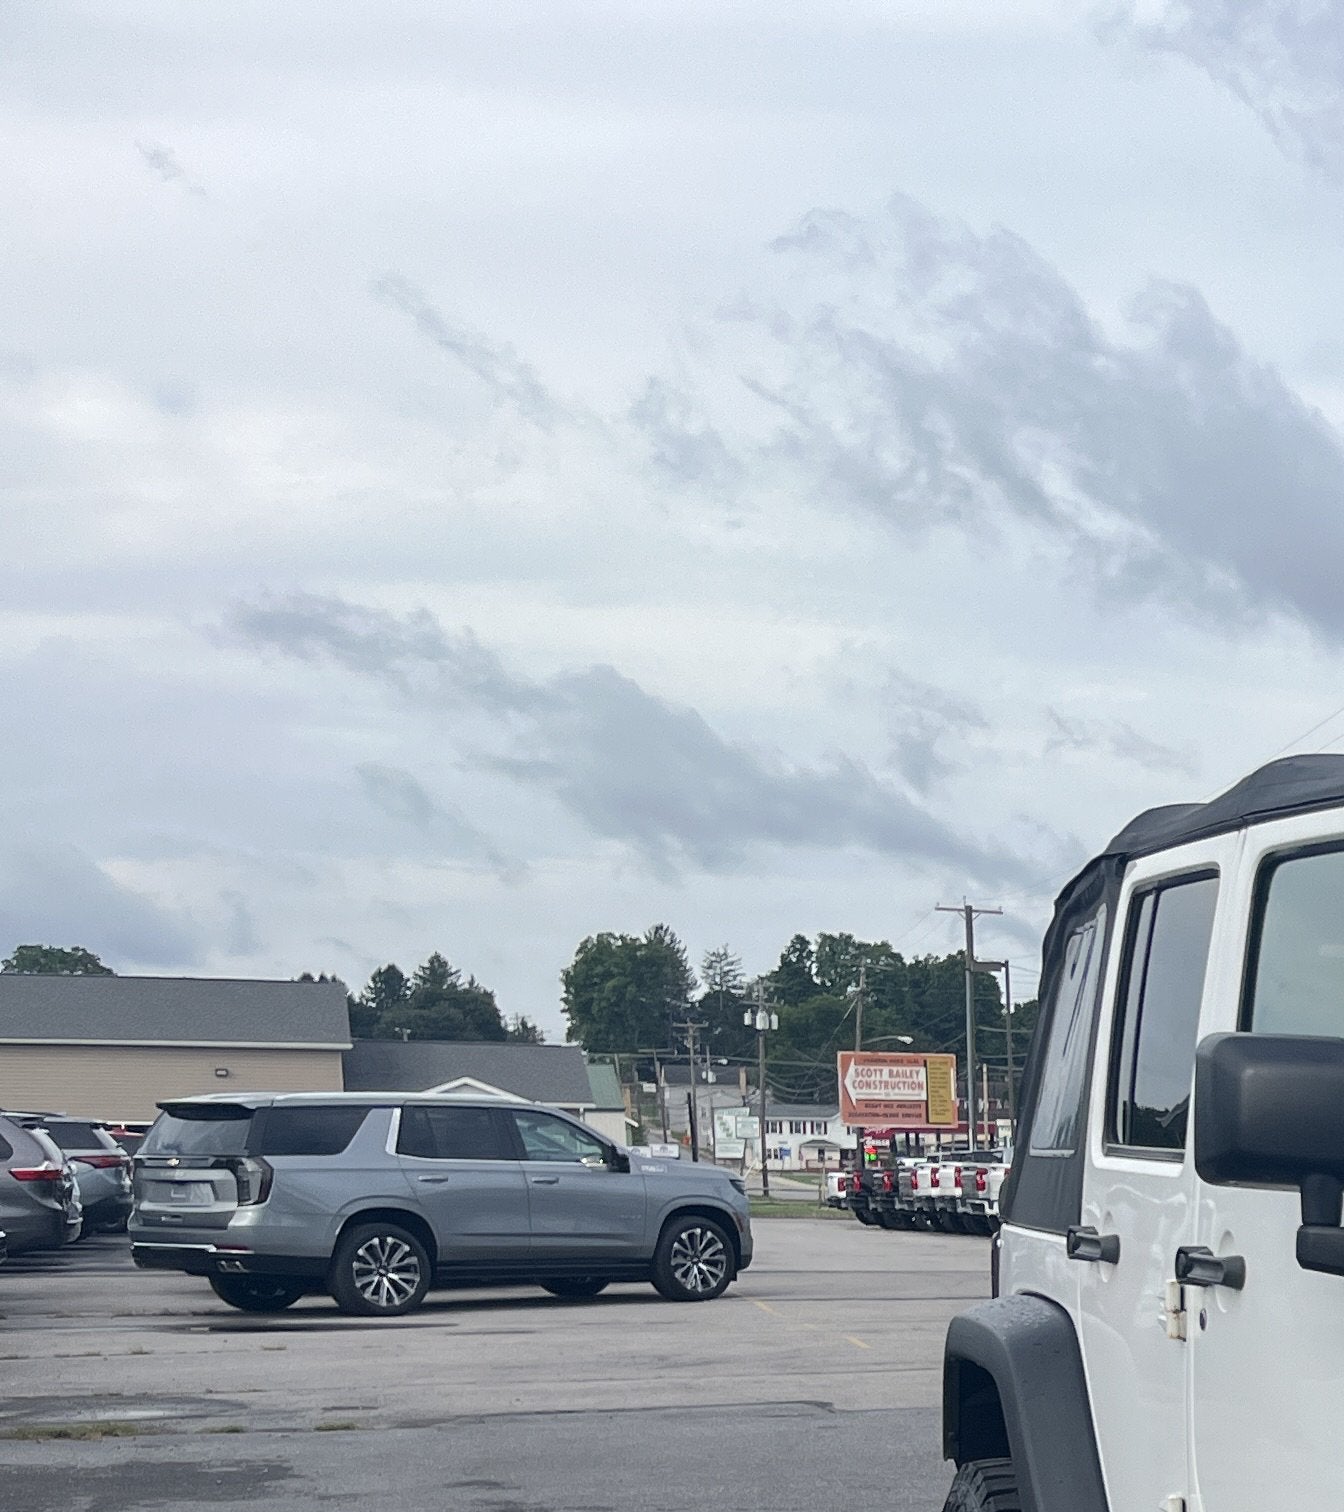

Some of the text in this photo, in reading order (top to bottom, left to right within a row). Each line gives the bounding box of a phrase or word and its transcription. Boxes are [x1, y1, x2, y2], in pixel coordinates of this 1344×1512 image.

[854, 1067, 921, 1079] SCOTT BAILEY
[852, 1080, 925, 1091] CONSTRUCTION
